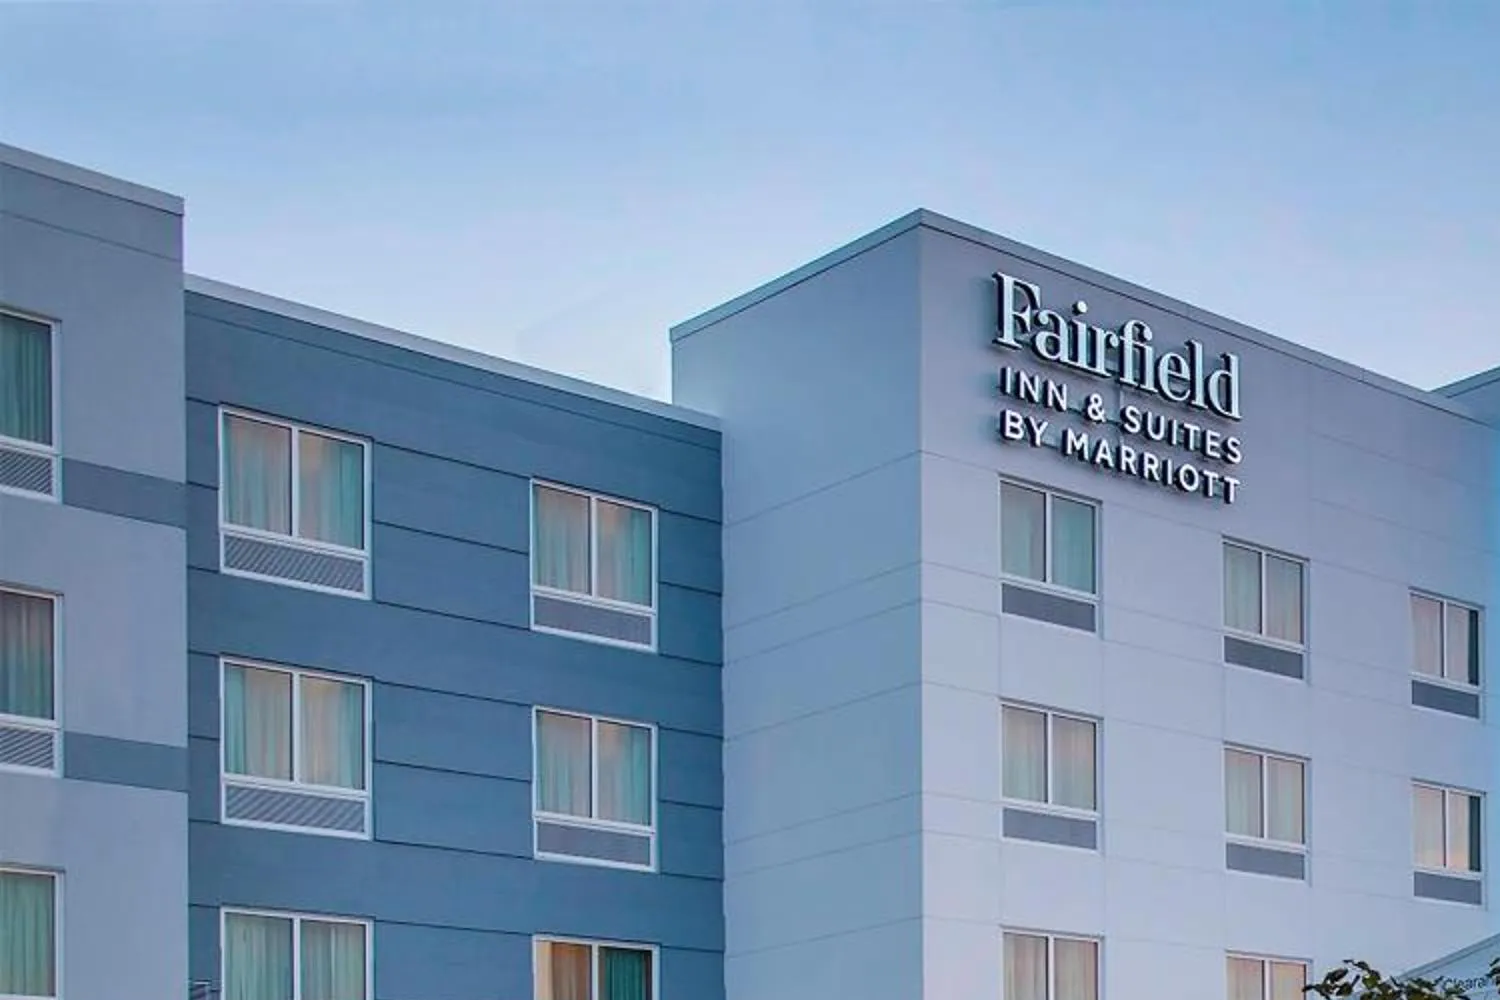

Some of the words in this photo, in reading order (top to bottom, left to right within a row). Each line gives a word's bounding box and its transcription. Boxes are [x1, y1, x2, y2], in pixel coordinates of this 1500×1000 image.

[993, 271, 1242, 421] Fairfield
[1002, 366, 1067, 413] INN
[1087, 393, 1107, 423] &
[1121, 405, 1242, 465] SUITES
[1002, 409, 1049, 447] BY
[1065, 428, 1240, 505] MARRIOTT
